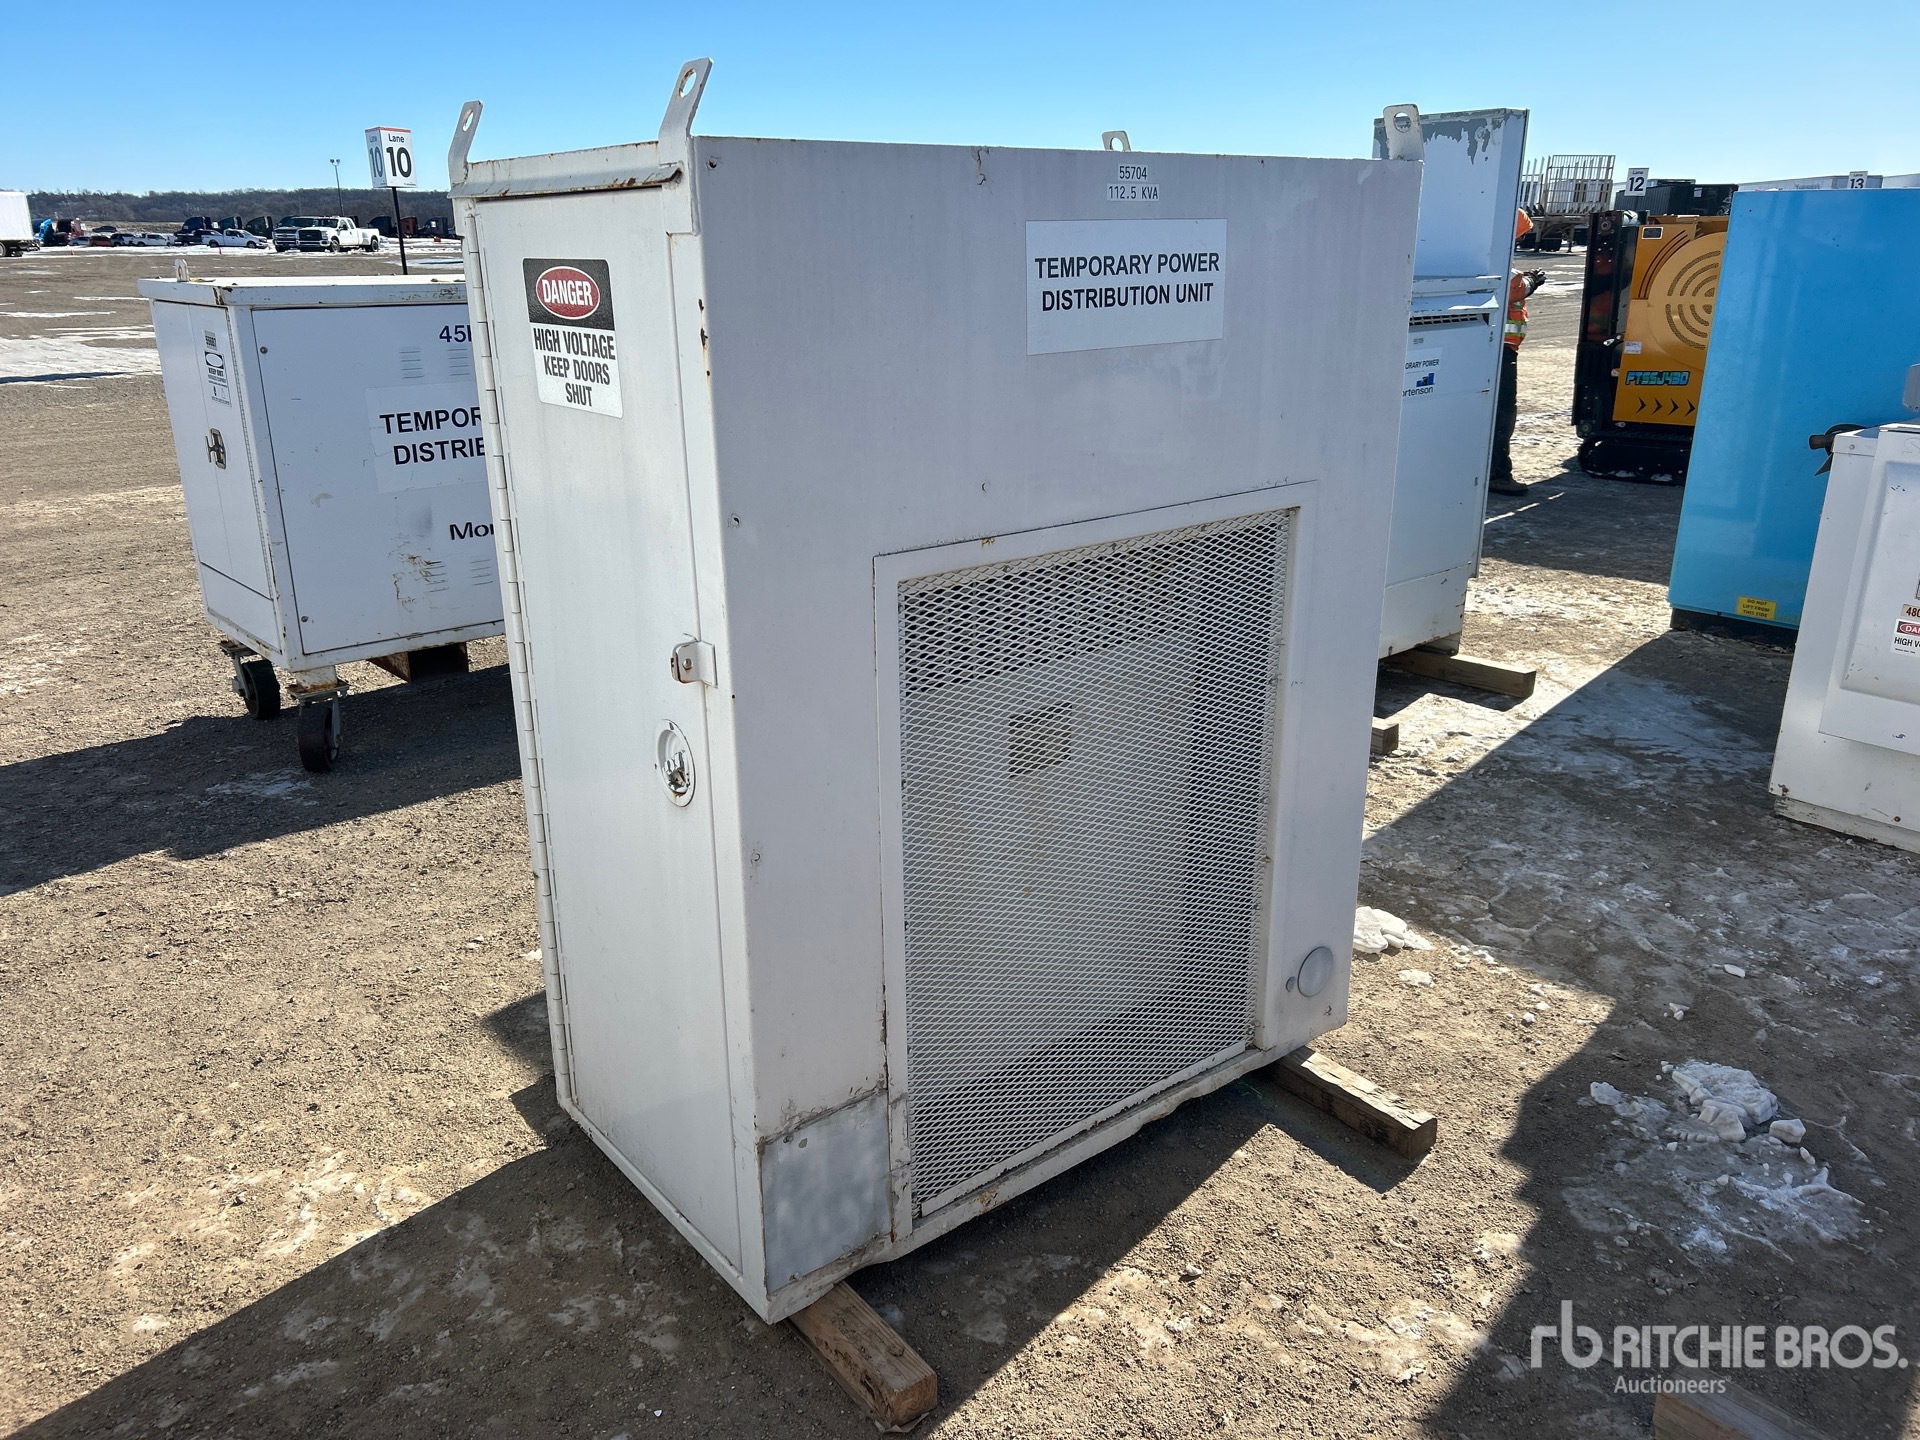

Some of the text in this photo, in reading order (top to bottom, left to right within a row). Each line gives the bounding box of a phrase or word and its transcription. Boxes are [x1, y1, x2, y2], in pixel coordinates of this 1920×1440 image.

[388, 133, 405, 143] Lane
[370, 146, 383, 178] 10
[386, 146, 412, 178] 10
[1119, 166, 1147, 180] 55704
[1108, 185, 1159, 200] 112.5 KVA
[1629, 176, 1645, 192] 12
[1850, 178, 1864, 189] 13
[1034, 252, 1220, 279] TEMPORARY POWER
[541, 278, 593, 307] DANGER
[1042, 282, 1214, 312] DISTRIBUTION UNIT
[533, 327, 616, 360] HIGH VOLTAGE
[543, 355, 610, 386] KEEP DOORS
[1422, 358, 1440, 367] POWER
[565, 382, 593, 407] SHUT
[1894, 637, 1913, 647] HIGH
